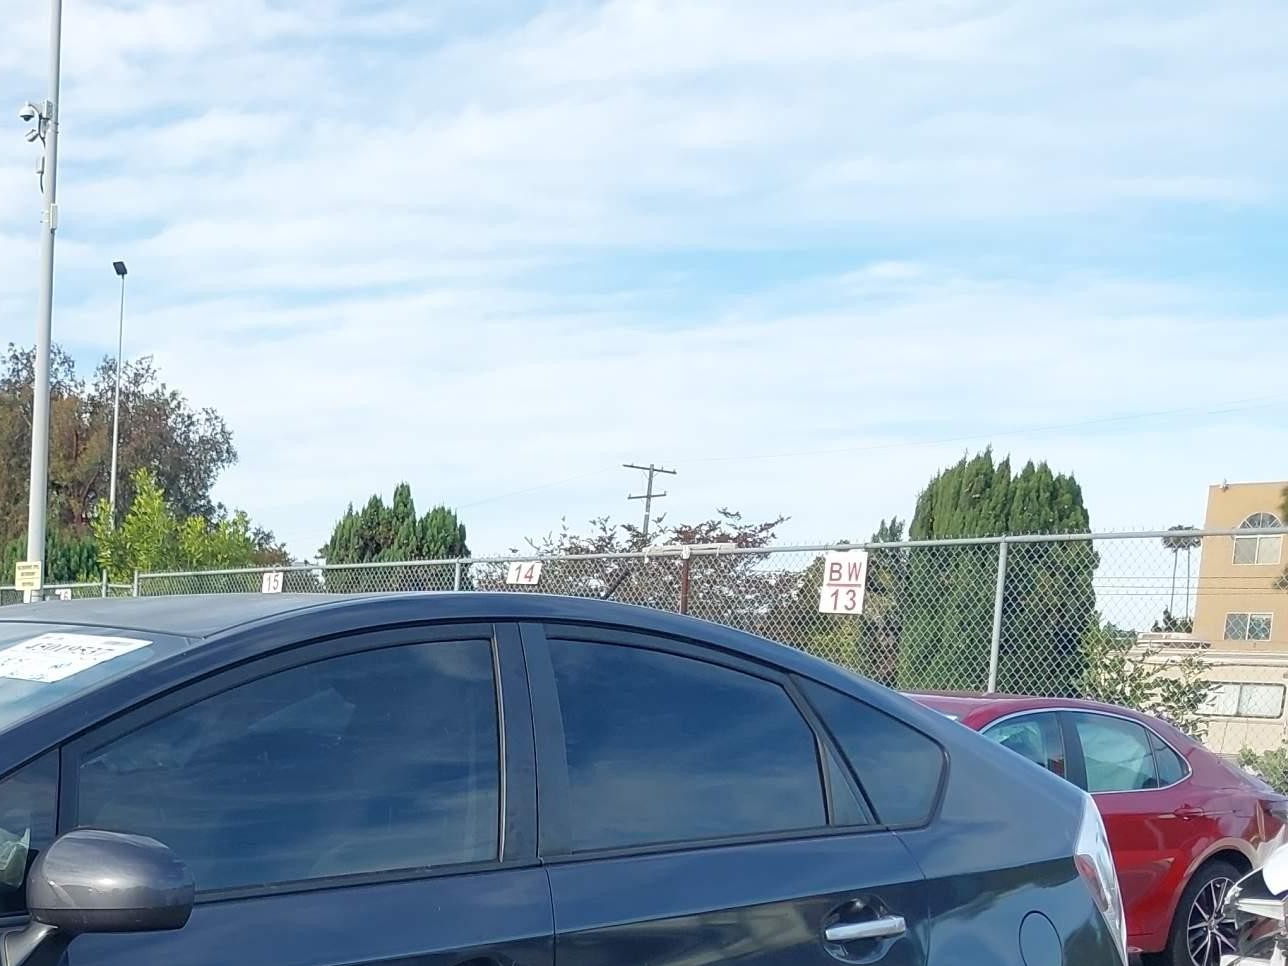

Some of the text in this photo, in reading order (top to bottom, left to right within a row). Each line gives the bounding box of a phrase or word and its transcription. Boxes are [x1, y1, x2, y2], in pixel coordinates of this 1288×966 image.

[515, 563, 535, 582] 14
[829, 562, 862, 582] BW
[267, 574, 280, 592] 15
[830, 588, 856, 611] 13
